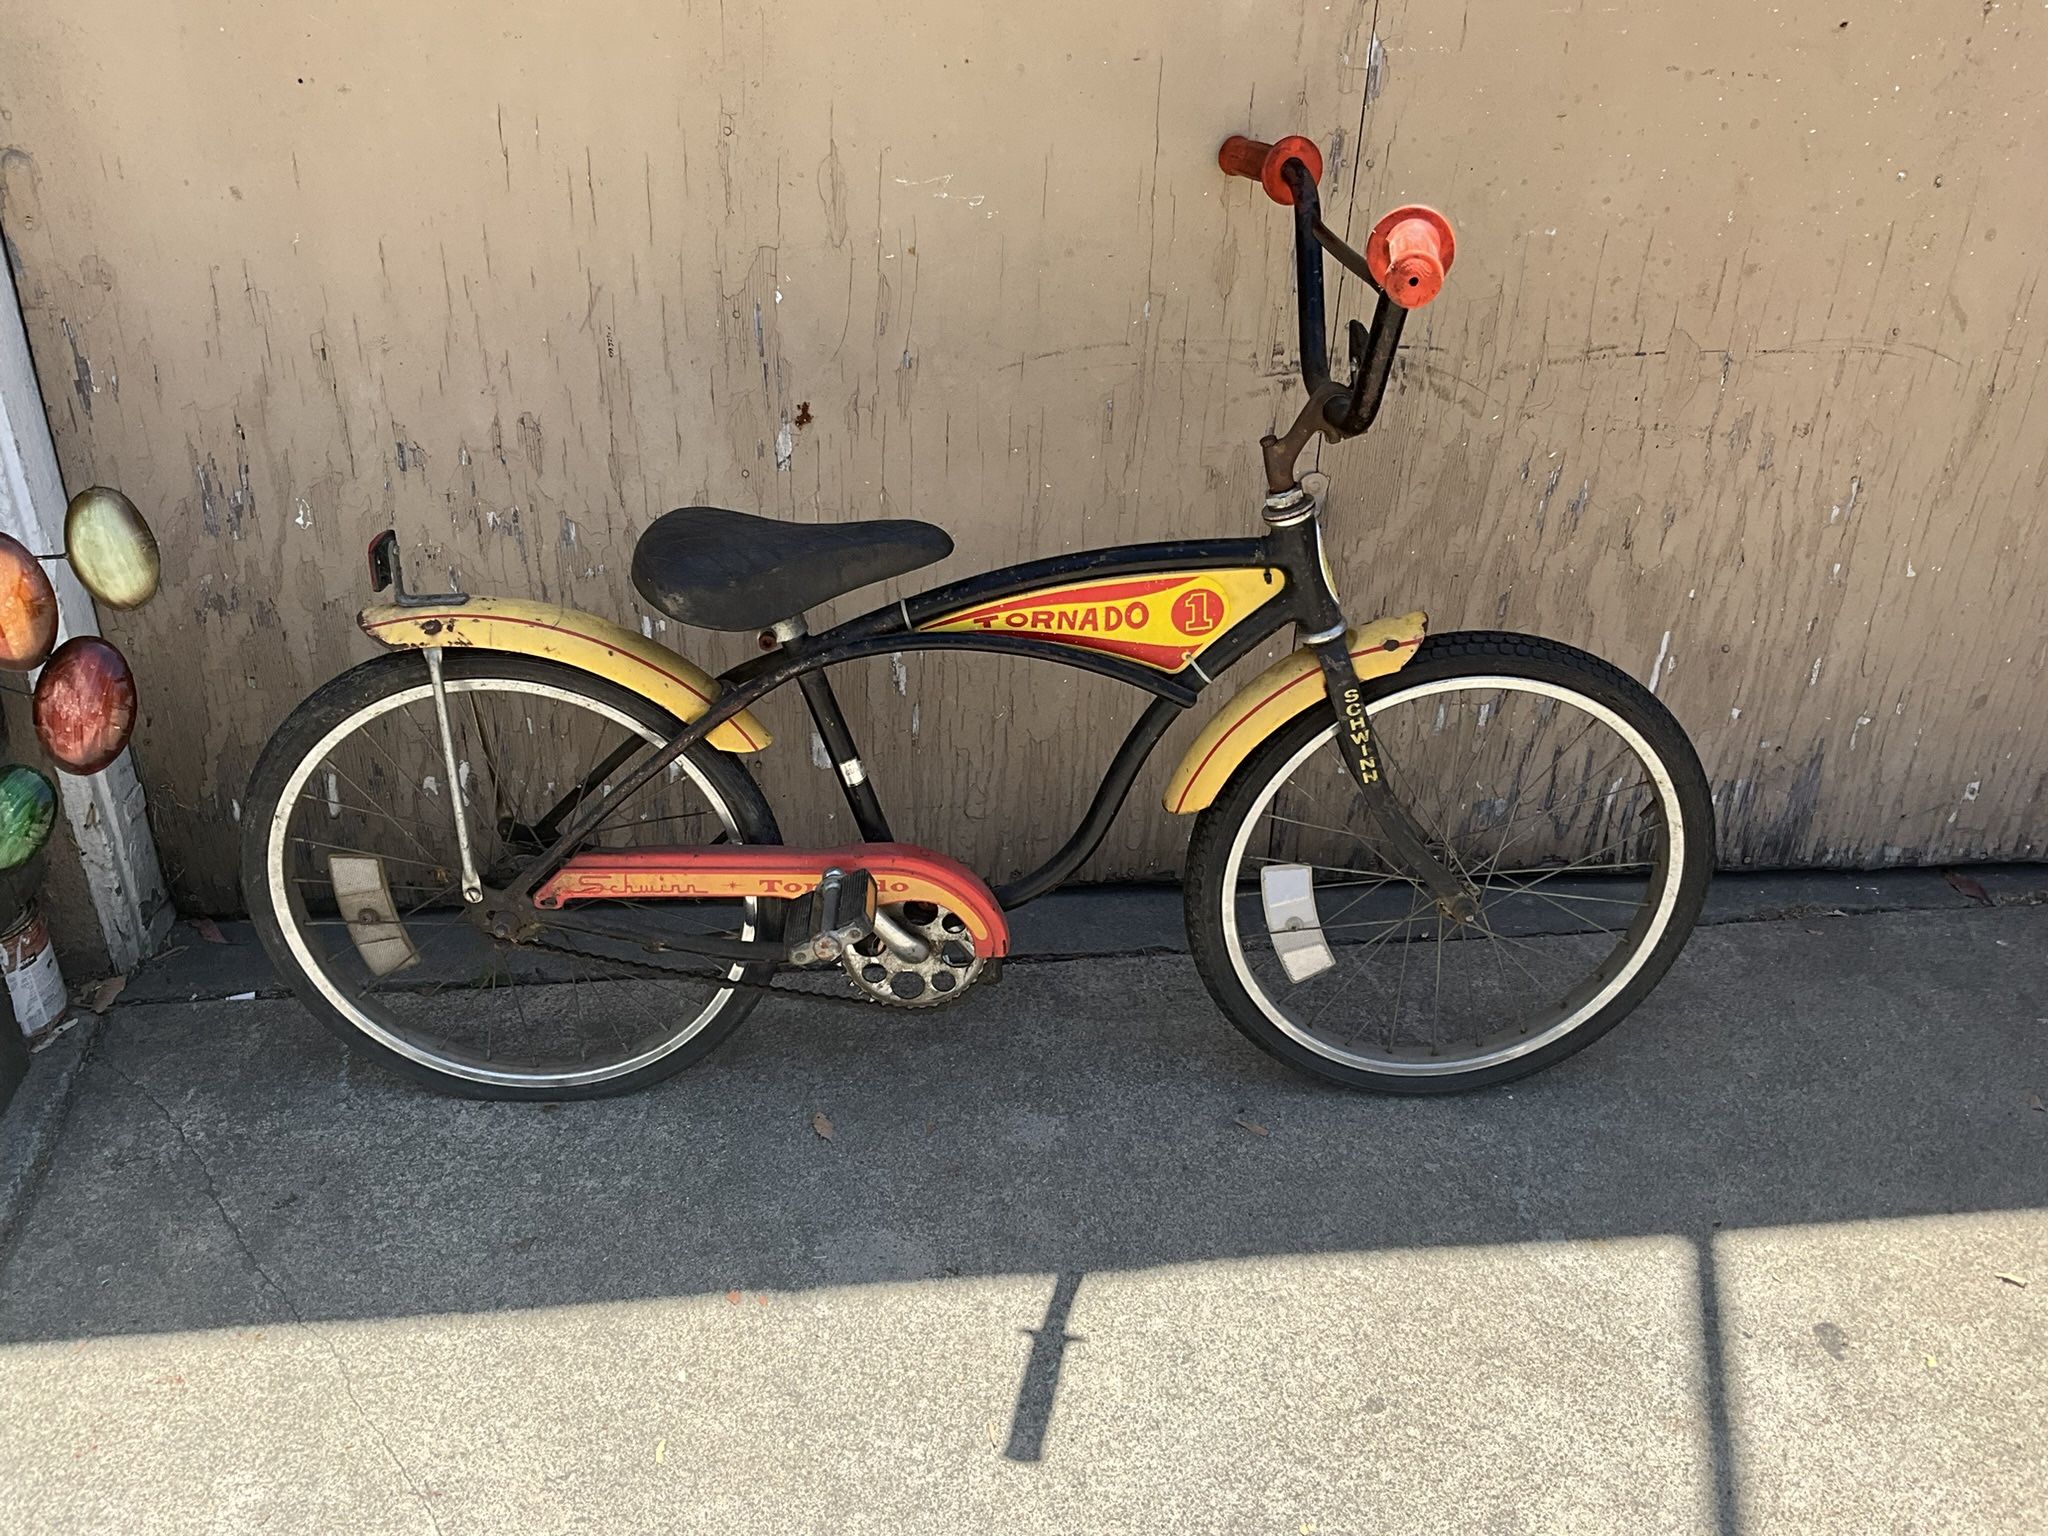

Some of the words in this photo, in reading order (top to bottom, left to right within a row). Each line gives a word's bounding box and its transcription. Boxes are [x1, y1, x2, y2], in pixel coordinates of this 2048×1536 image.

[973, 601, 1149, 631] TORNADO
[1185, 592, 1213, 631] 1
[1343, 688, 1379, 784] SCHWINN
[565, 873, 709, 893] Schwinn
[759, 879, 909, 893] Tordo
